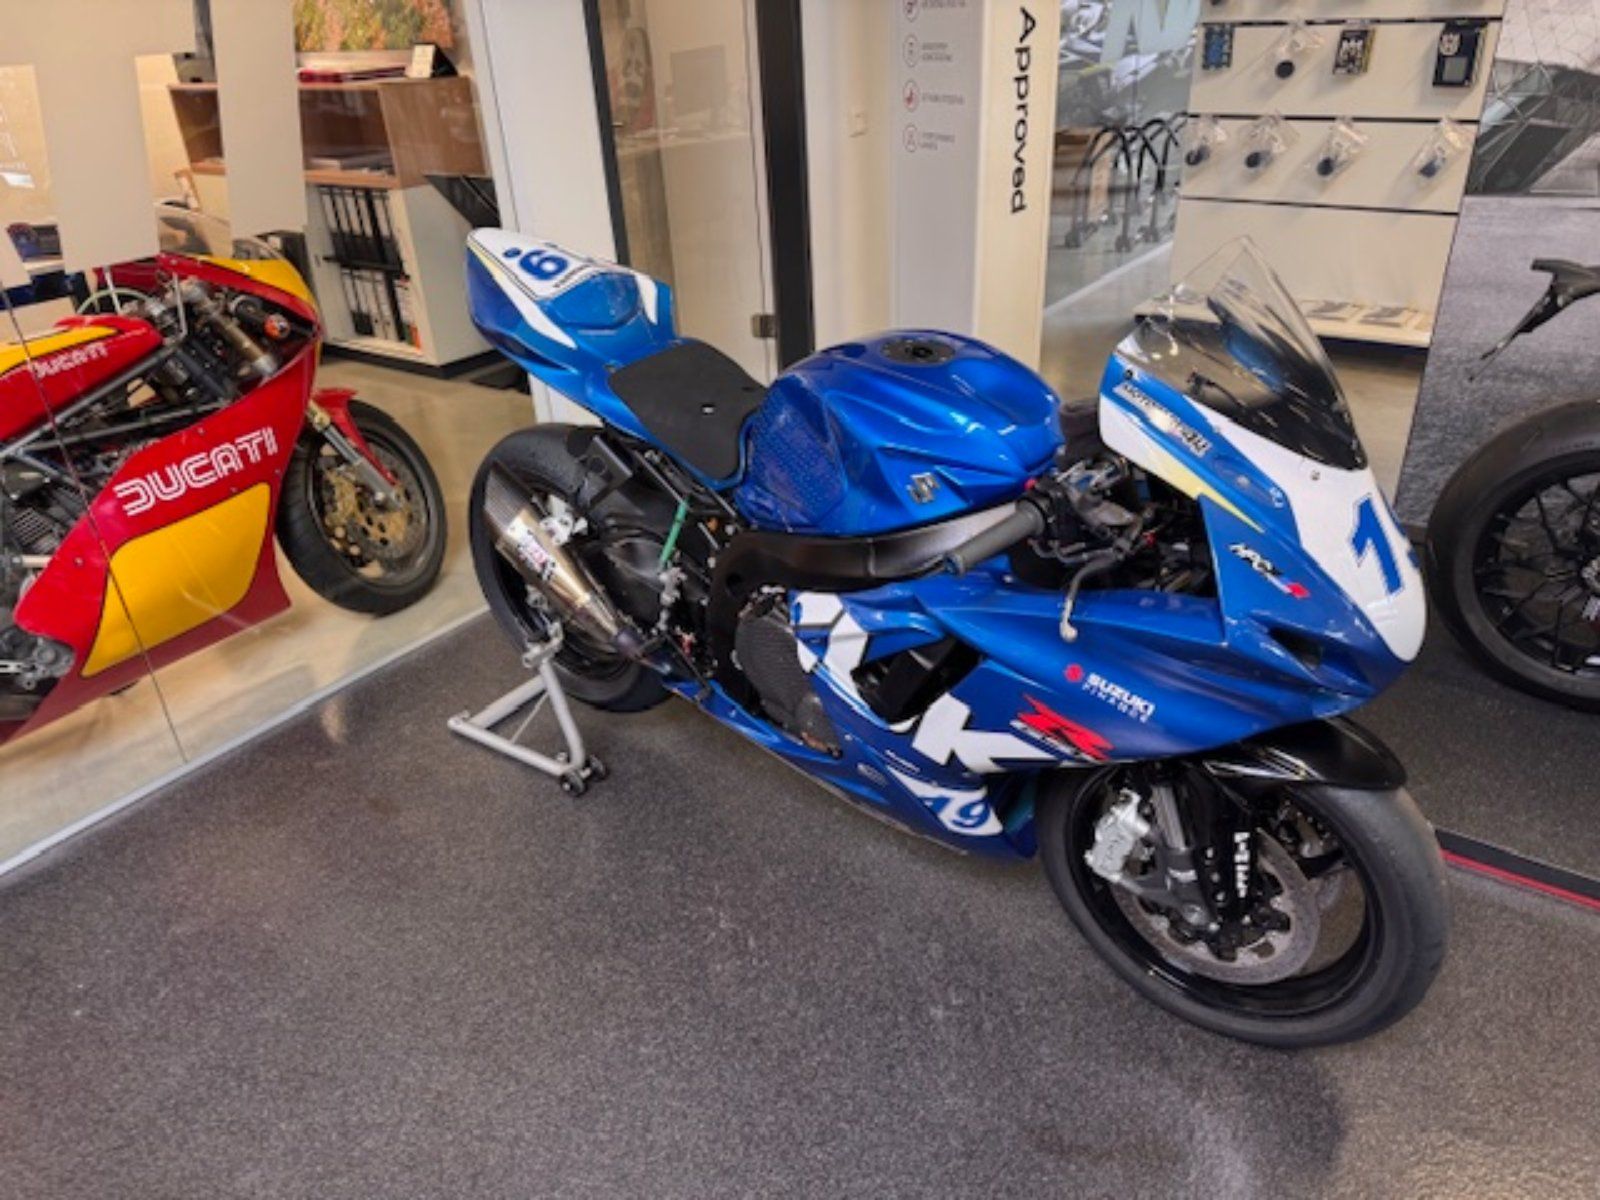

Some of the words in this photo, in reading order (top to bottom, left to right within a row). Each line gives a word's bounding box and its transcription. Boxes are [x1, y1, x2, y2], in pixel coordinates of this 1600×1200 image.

[1011, 6, 1036, 215] Approved
[113, 426, 278, 517] DUCATI
[1087, 672, 1156, 717] SUZUKI
